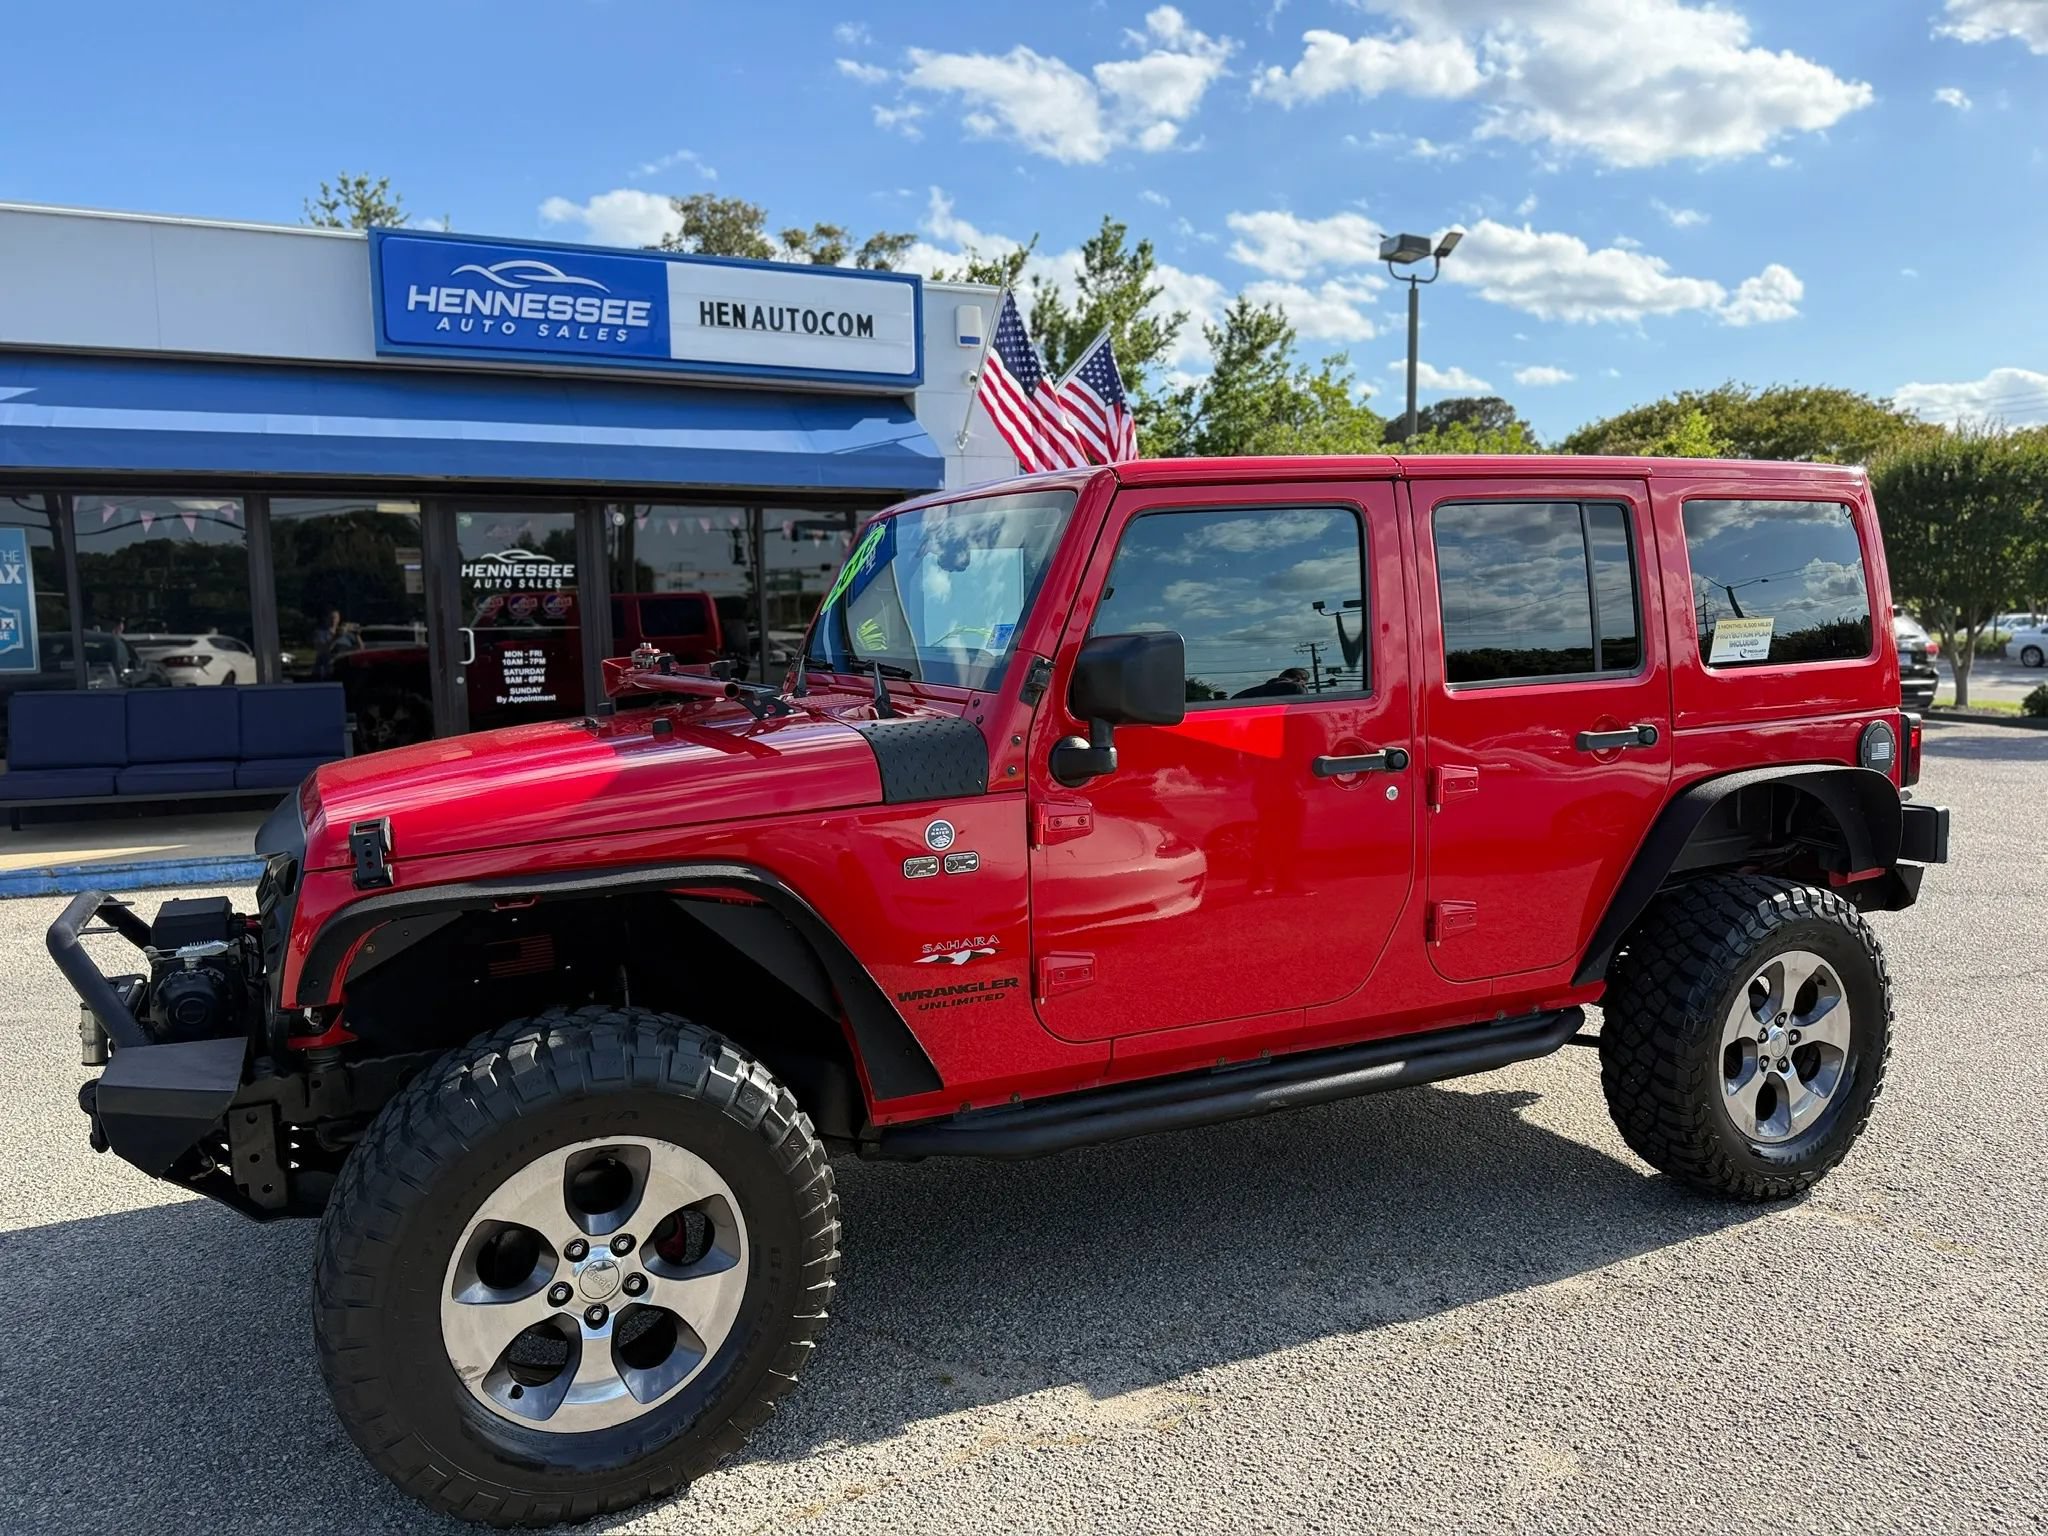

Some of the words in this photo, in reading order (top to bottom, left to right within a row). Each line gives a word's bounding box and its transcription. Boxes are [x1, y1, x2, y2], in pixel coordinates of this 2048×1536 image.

[407, 285, 651, 327] HENNESSEE
[699, 301, 874, 338] HENAUTO.COM
[436, 317, 516, 335] AUTO
[537, 324, 628, 342] SALES
[461, 564, 575, 577] HENNESSEE
[473, 578, 512, 589] AUTO
[518, 578, 562, 589] SALES
[504, 650, 523, 658] MON
[503, 667, 546, 676] SATURDAY
[528, 675, 545, 683] 6PM
[510, 686, 542, 695] SUNDAY
[496, 695, 507, 704] By
[509, 694, 556, 704] Appointment
[922, 934, 1000, 953] SAHARA
[897, 977, 1020, 1002] WRANGLER
[918, 992, 1006, 1011] UNLIMITED
